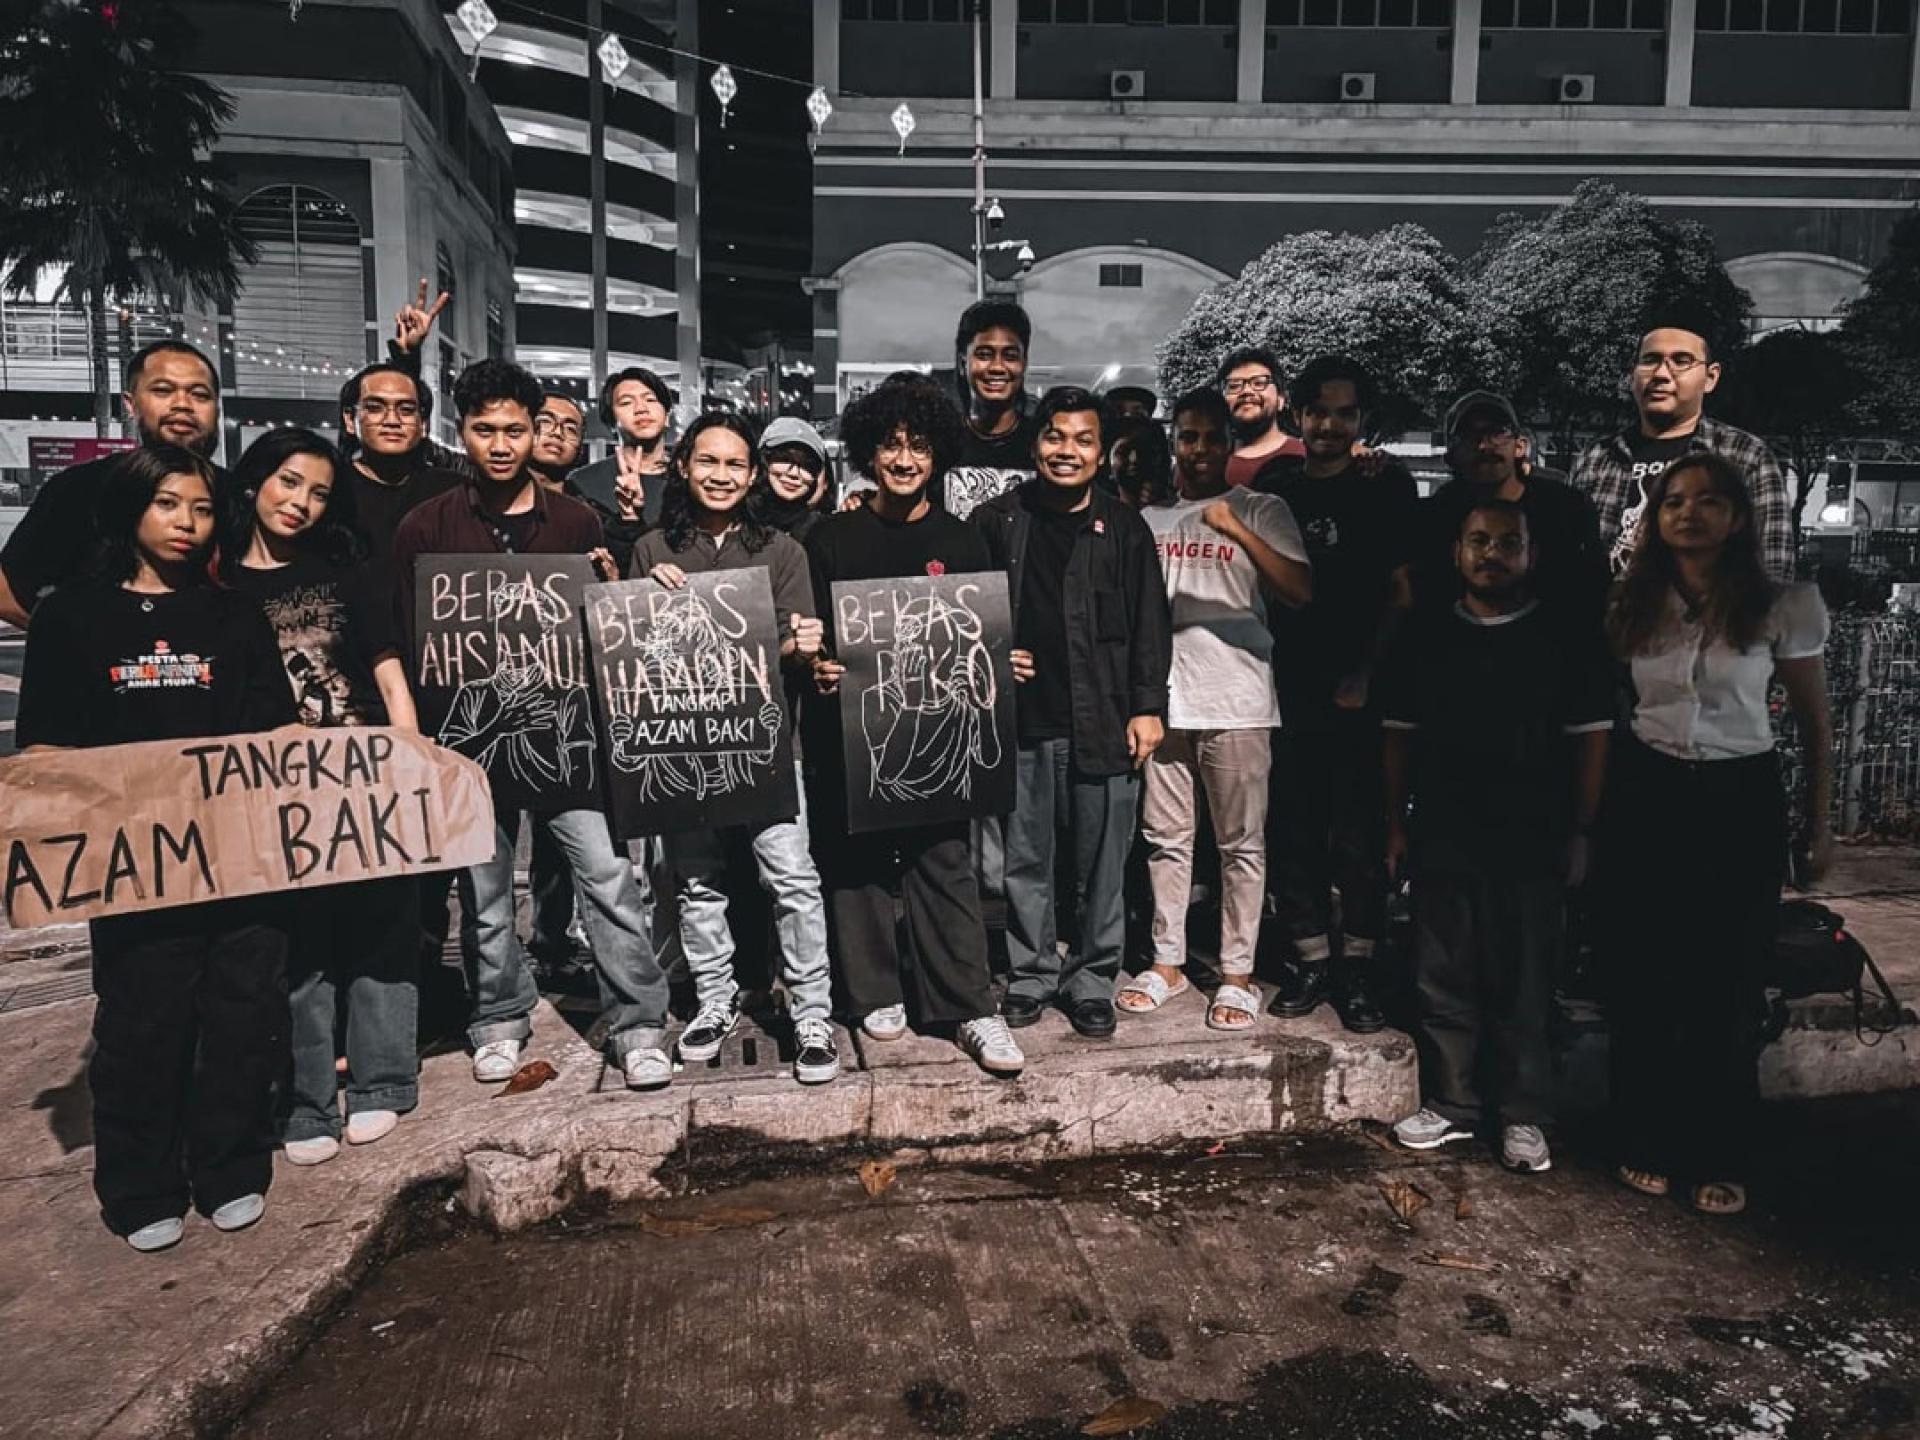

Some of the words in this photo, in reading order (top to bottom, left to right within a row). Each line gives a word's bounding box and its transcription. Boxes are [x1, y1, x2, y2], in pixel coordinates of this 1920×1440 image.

[432, 570, 572, 624] BEBAS
[595, 584, 748, 653] BEBAS
[839, 585, 982, 645] BEBAS
[420, 630, 590, 690] AHSANUL
[635, 717, 698, 746] AZAM
[705, 716, 755, 745] BAKI
[650, 693, 731, 713] TANGKAP
[183, 734, 393, 799] TANGKAP
[4, 820, 216, 917] AZAM
[278, 788, 442, 882] BAKI
